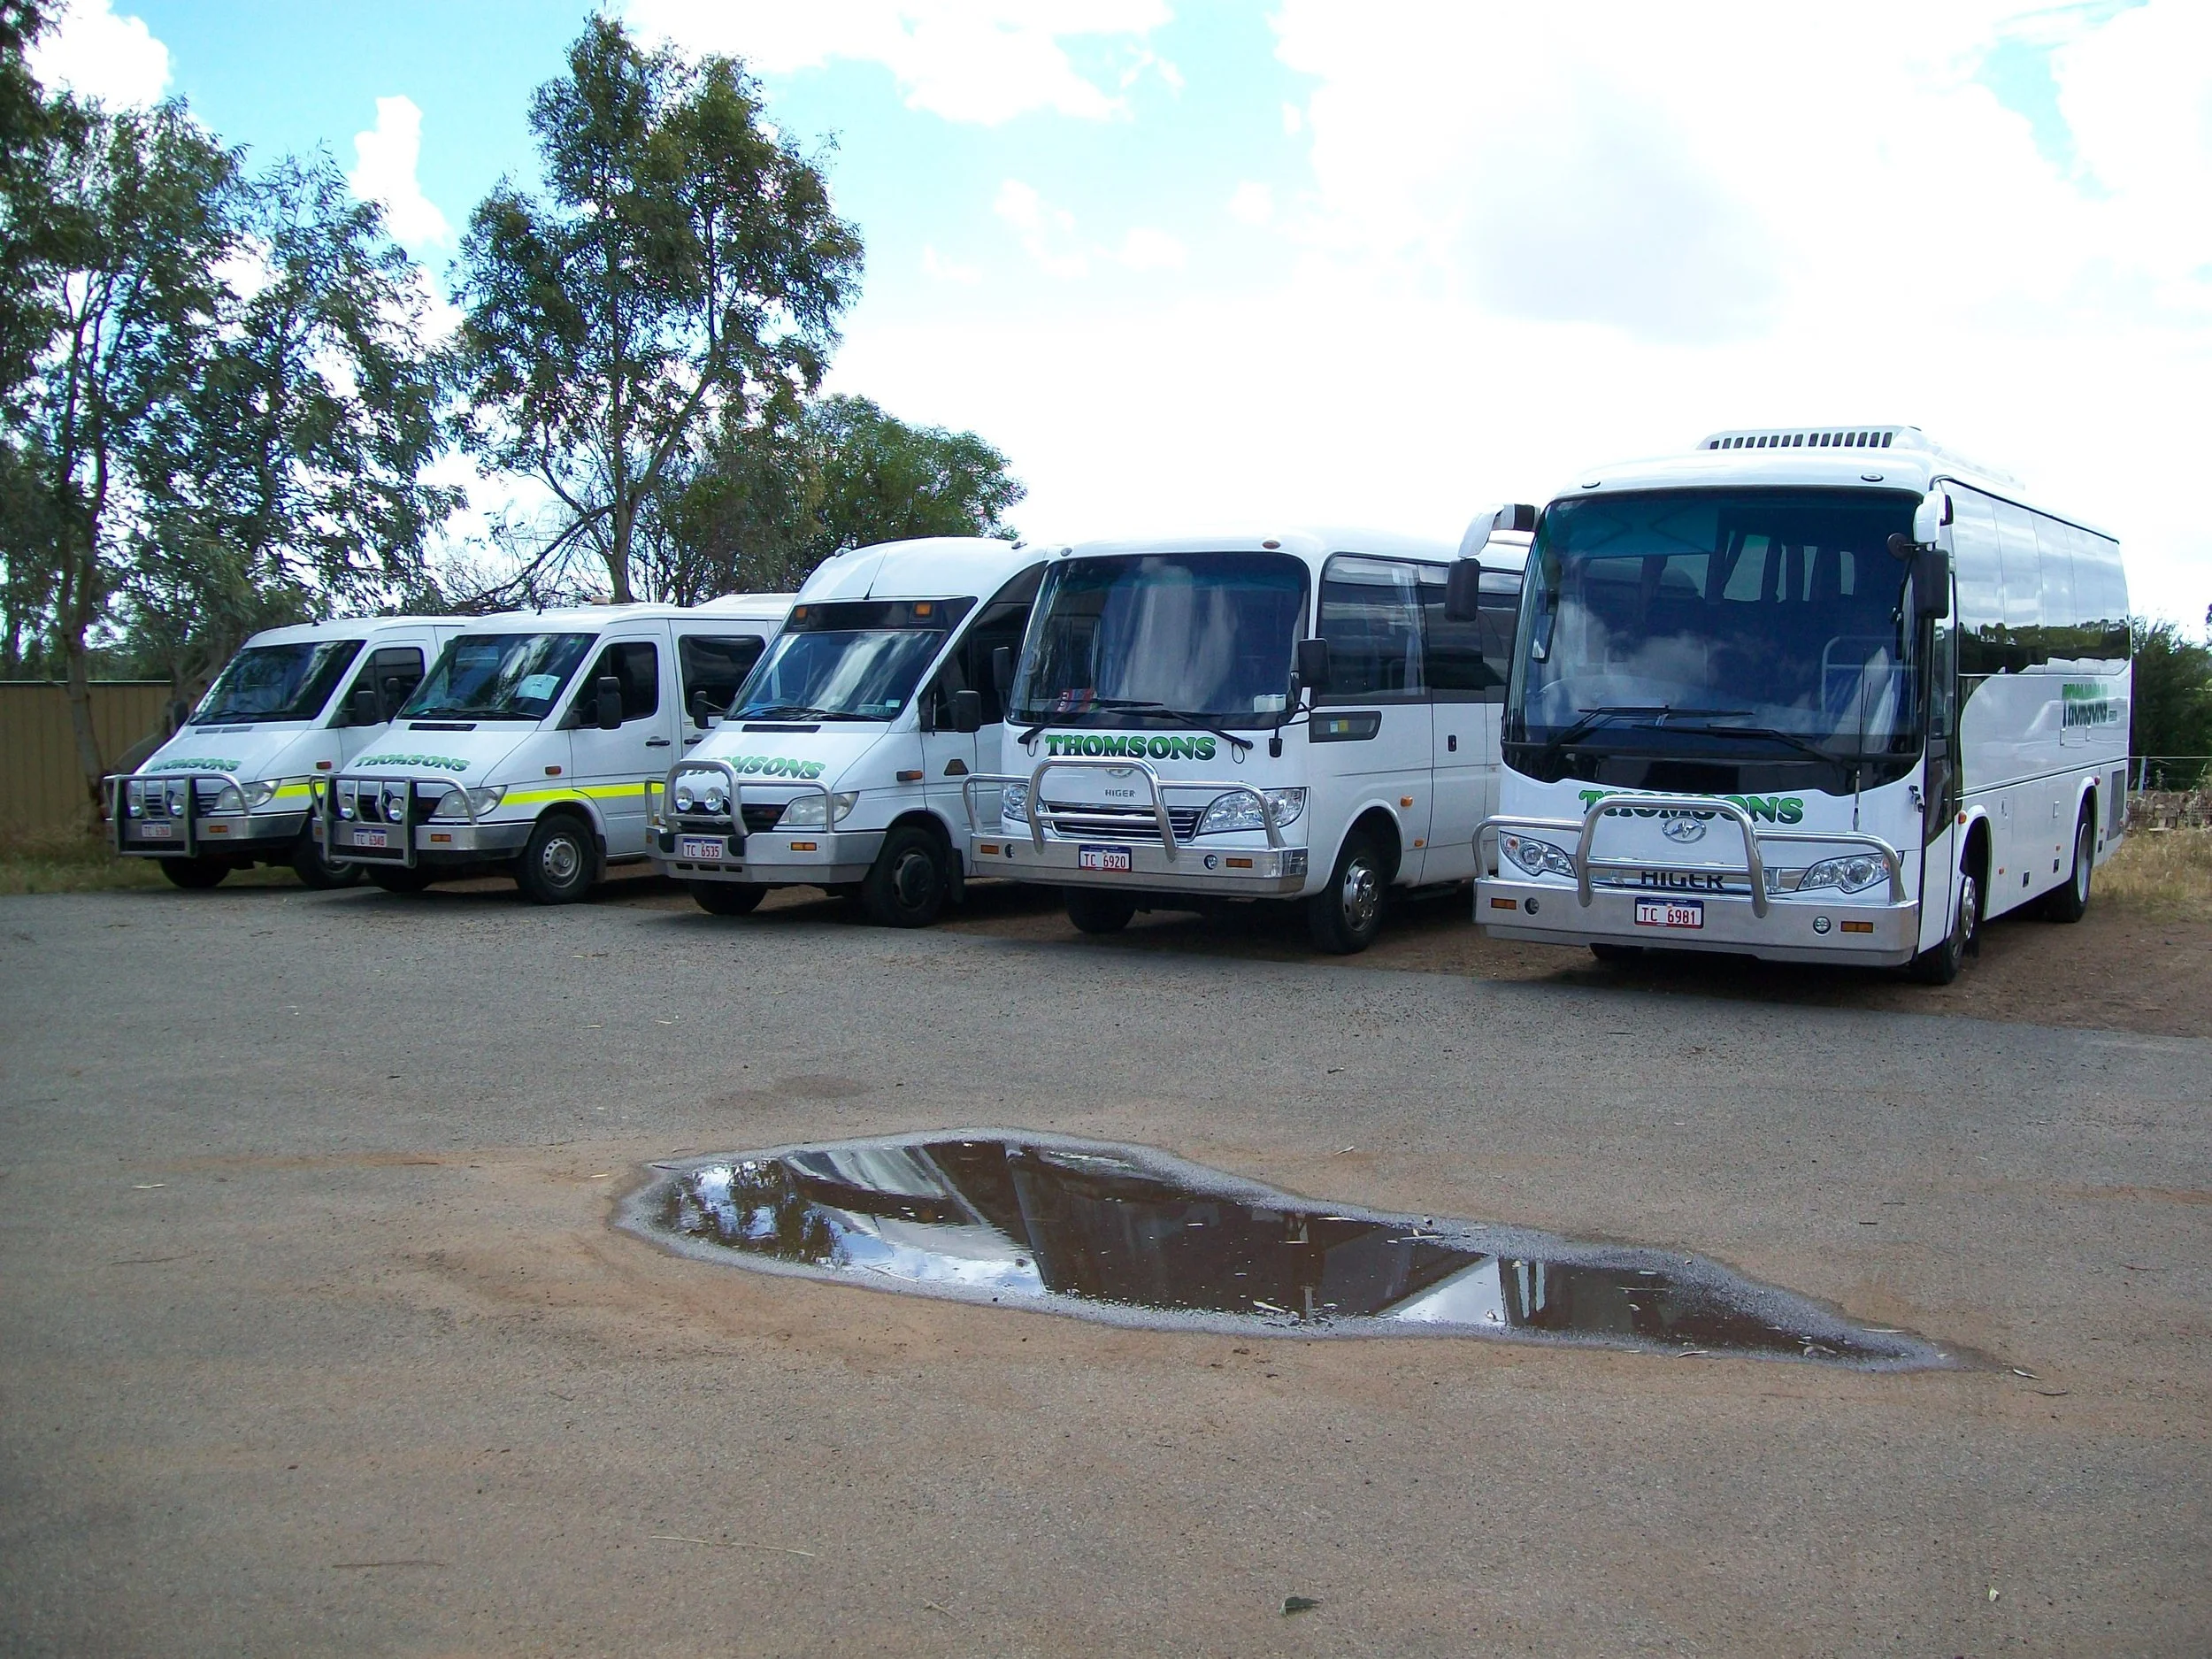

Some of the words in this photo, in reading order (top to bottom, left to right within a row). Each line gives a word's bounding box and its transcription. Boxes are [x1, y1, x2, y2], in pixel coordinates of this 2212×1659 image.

[1045, 734, 1217, 761] THOMSONS
[354, 754, 471, 772] THOMSONS
[679, 756, 826, 780] MSONS
[1578, 790, 1804, 824] TONS
[356, 833, 365, 845] TC
[686, 844, 696, 856] TC
[701, 845, 719, 857] 6535
[1084, 853, 1096, 866] TC
[1103, 855, 1125, 868] 6920
[1641, 871, 1724, 889] HIGER
[1641, 907, 1657, 922] TC
[1667, 909, 1695, 925] 6981
